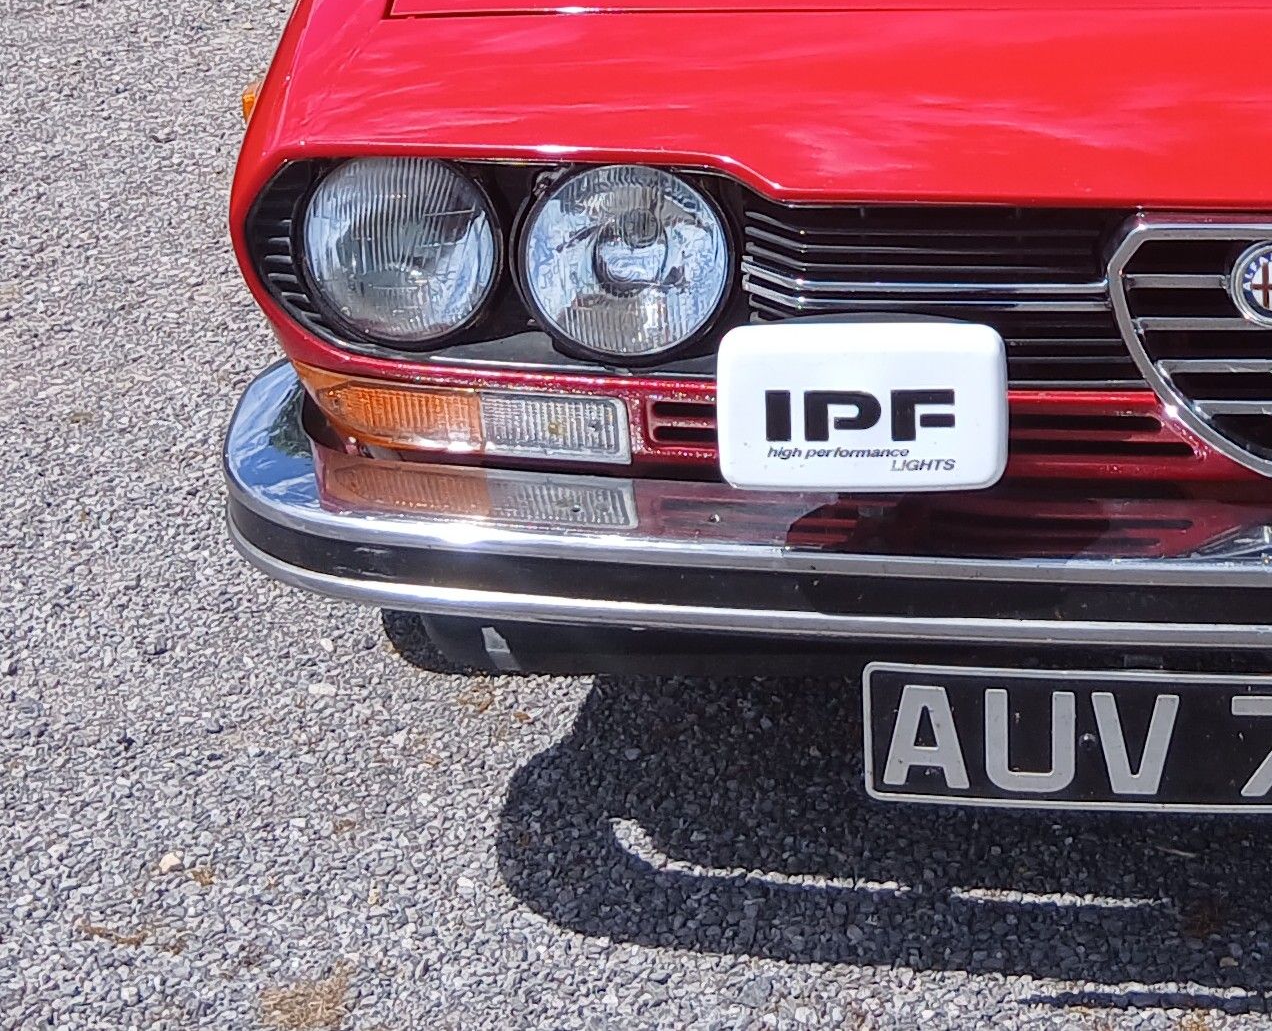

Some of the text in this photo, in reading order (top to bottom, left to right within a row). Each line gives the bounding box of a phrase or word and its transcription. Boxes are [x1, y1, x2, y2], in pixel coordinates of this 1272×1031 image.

[765, 388, 956, 442] IPF
[767, 446, 910, 460] high performance
[889, 458, 956, 472] LIGHTS
[881, 683, 1181, 797] AUV
